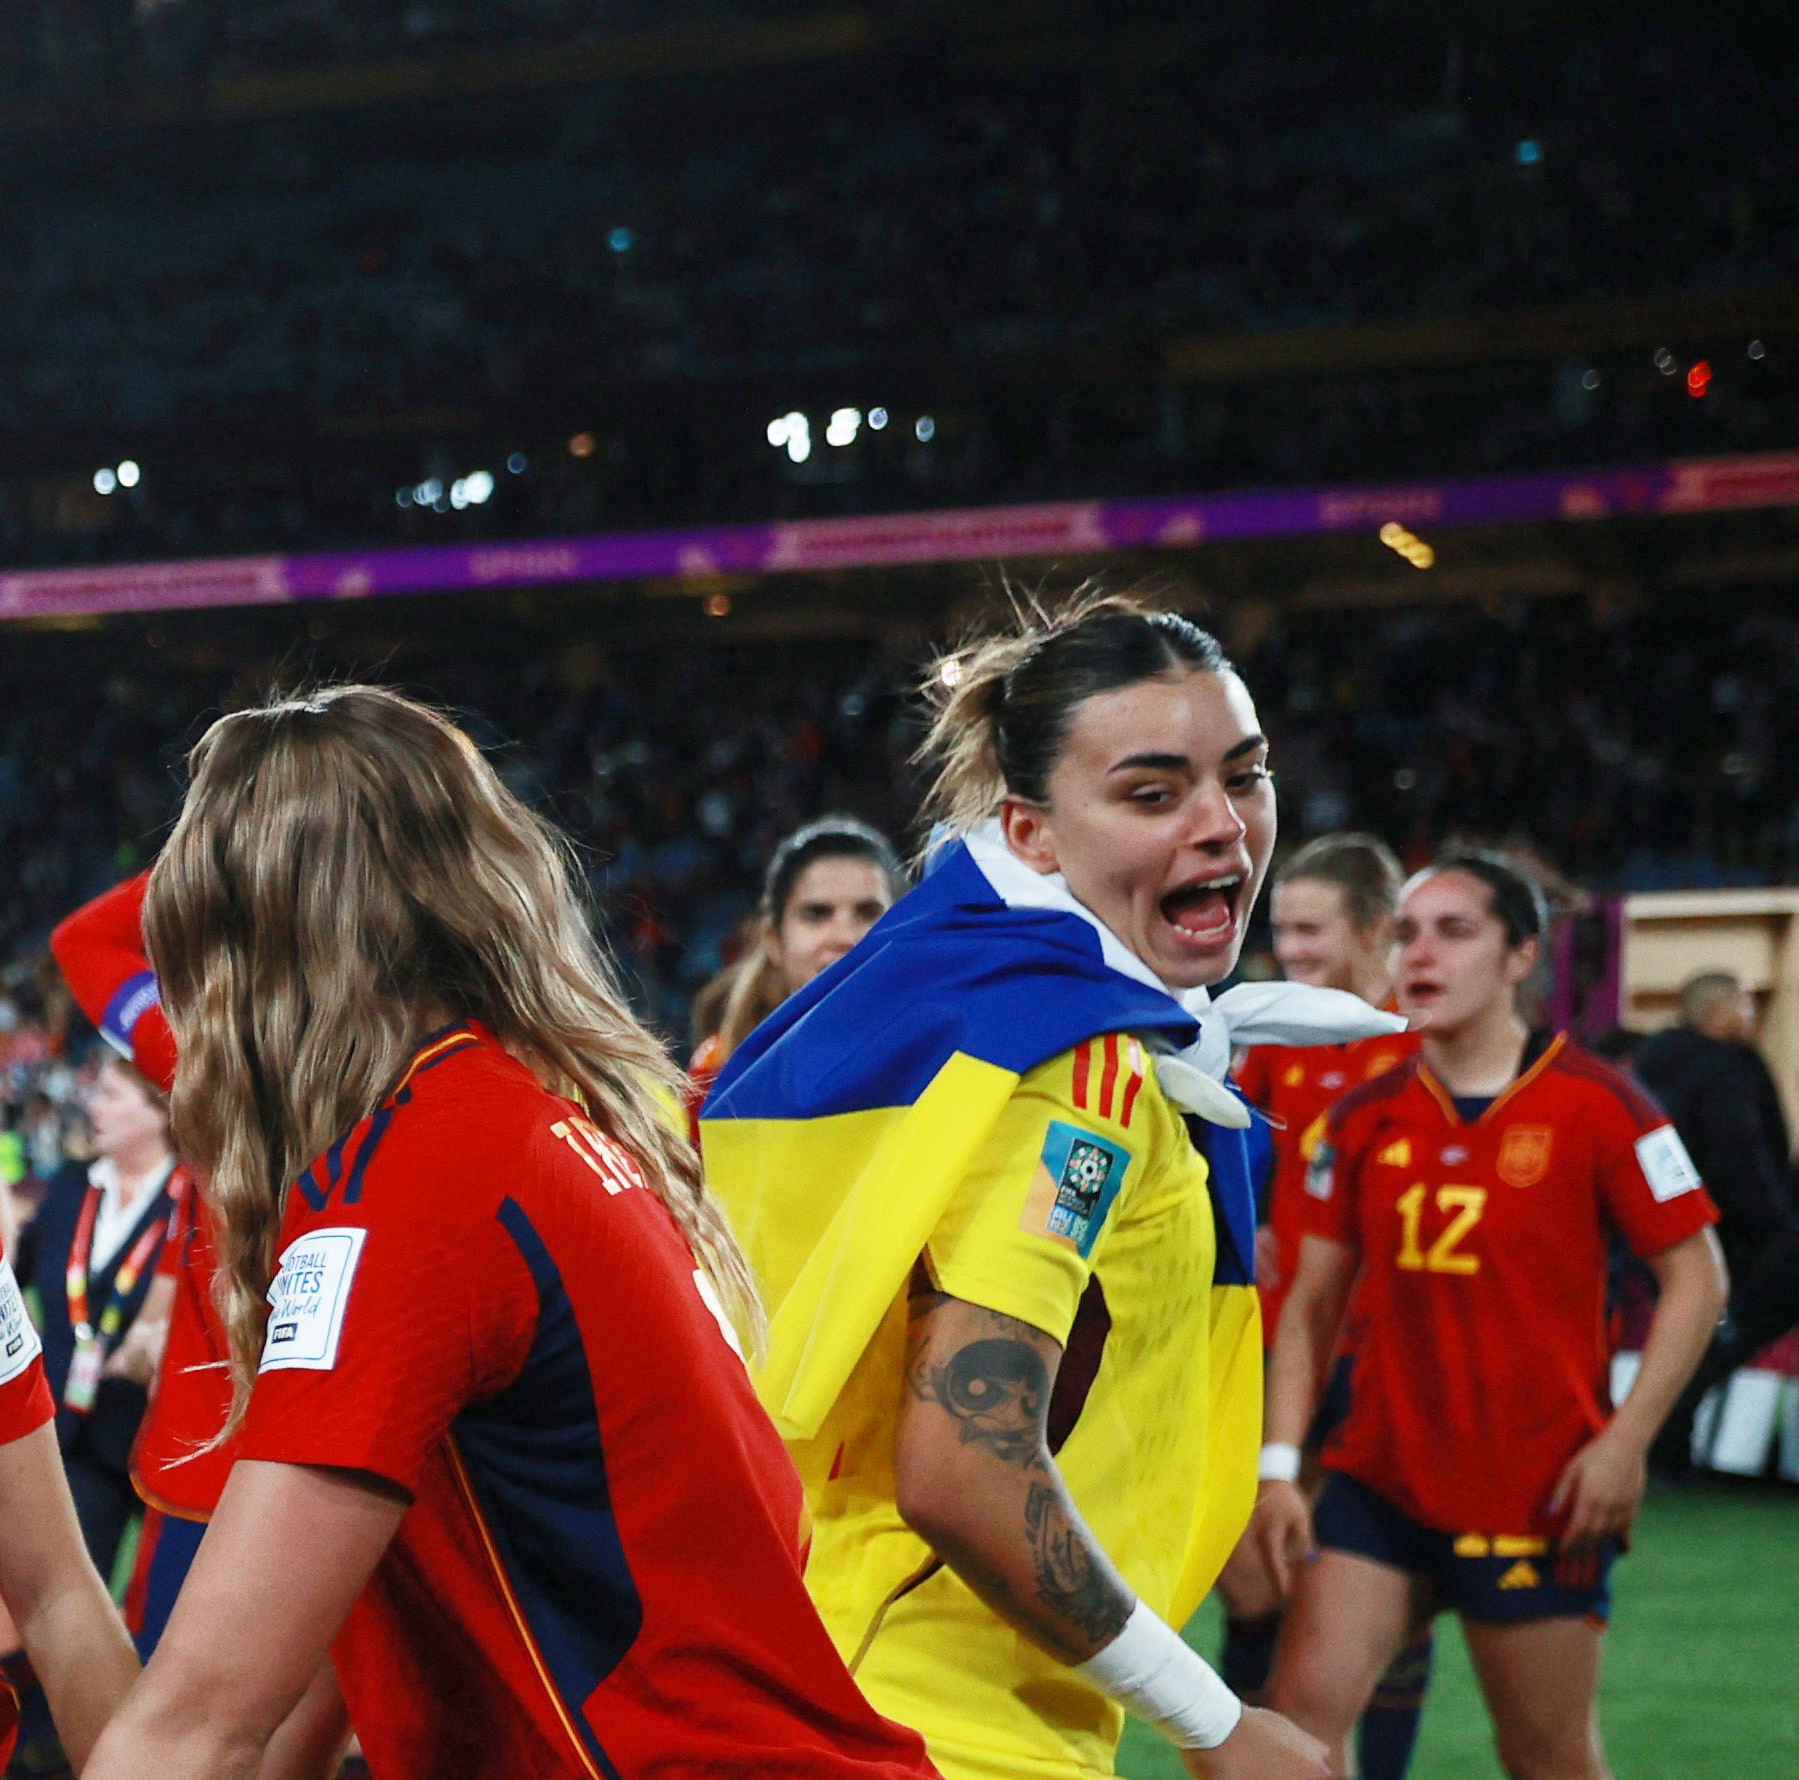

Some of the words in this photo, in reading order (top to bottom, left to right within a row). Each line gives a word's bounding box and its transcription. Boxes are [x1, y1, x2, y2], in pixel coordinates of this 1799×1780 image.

[1395, 1182, 1488, 1276] 12
[282, 1253, 326, 1274] OTBALL
[277, 1271, 323, 1297] NITES
[274, 1326, 295, 1340] FIFA
